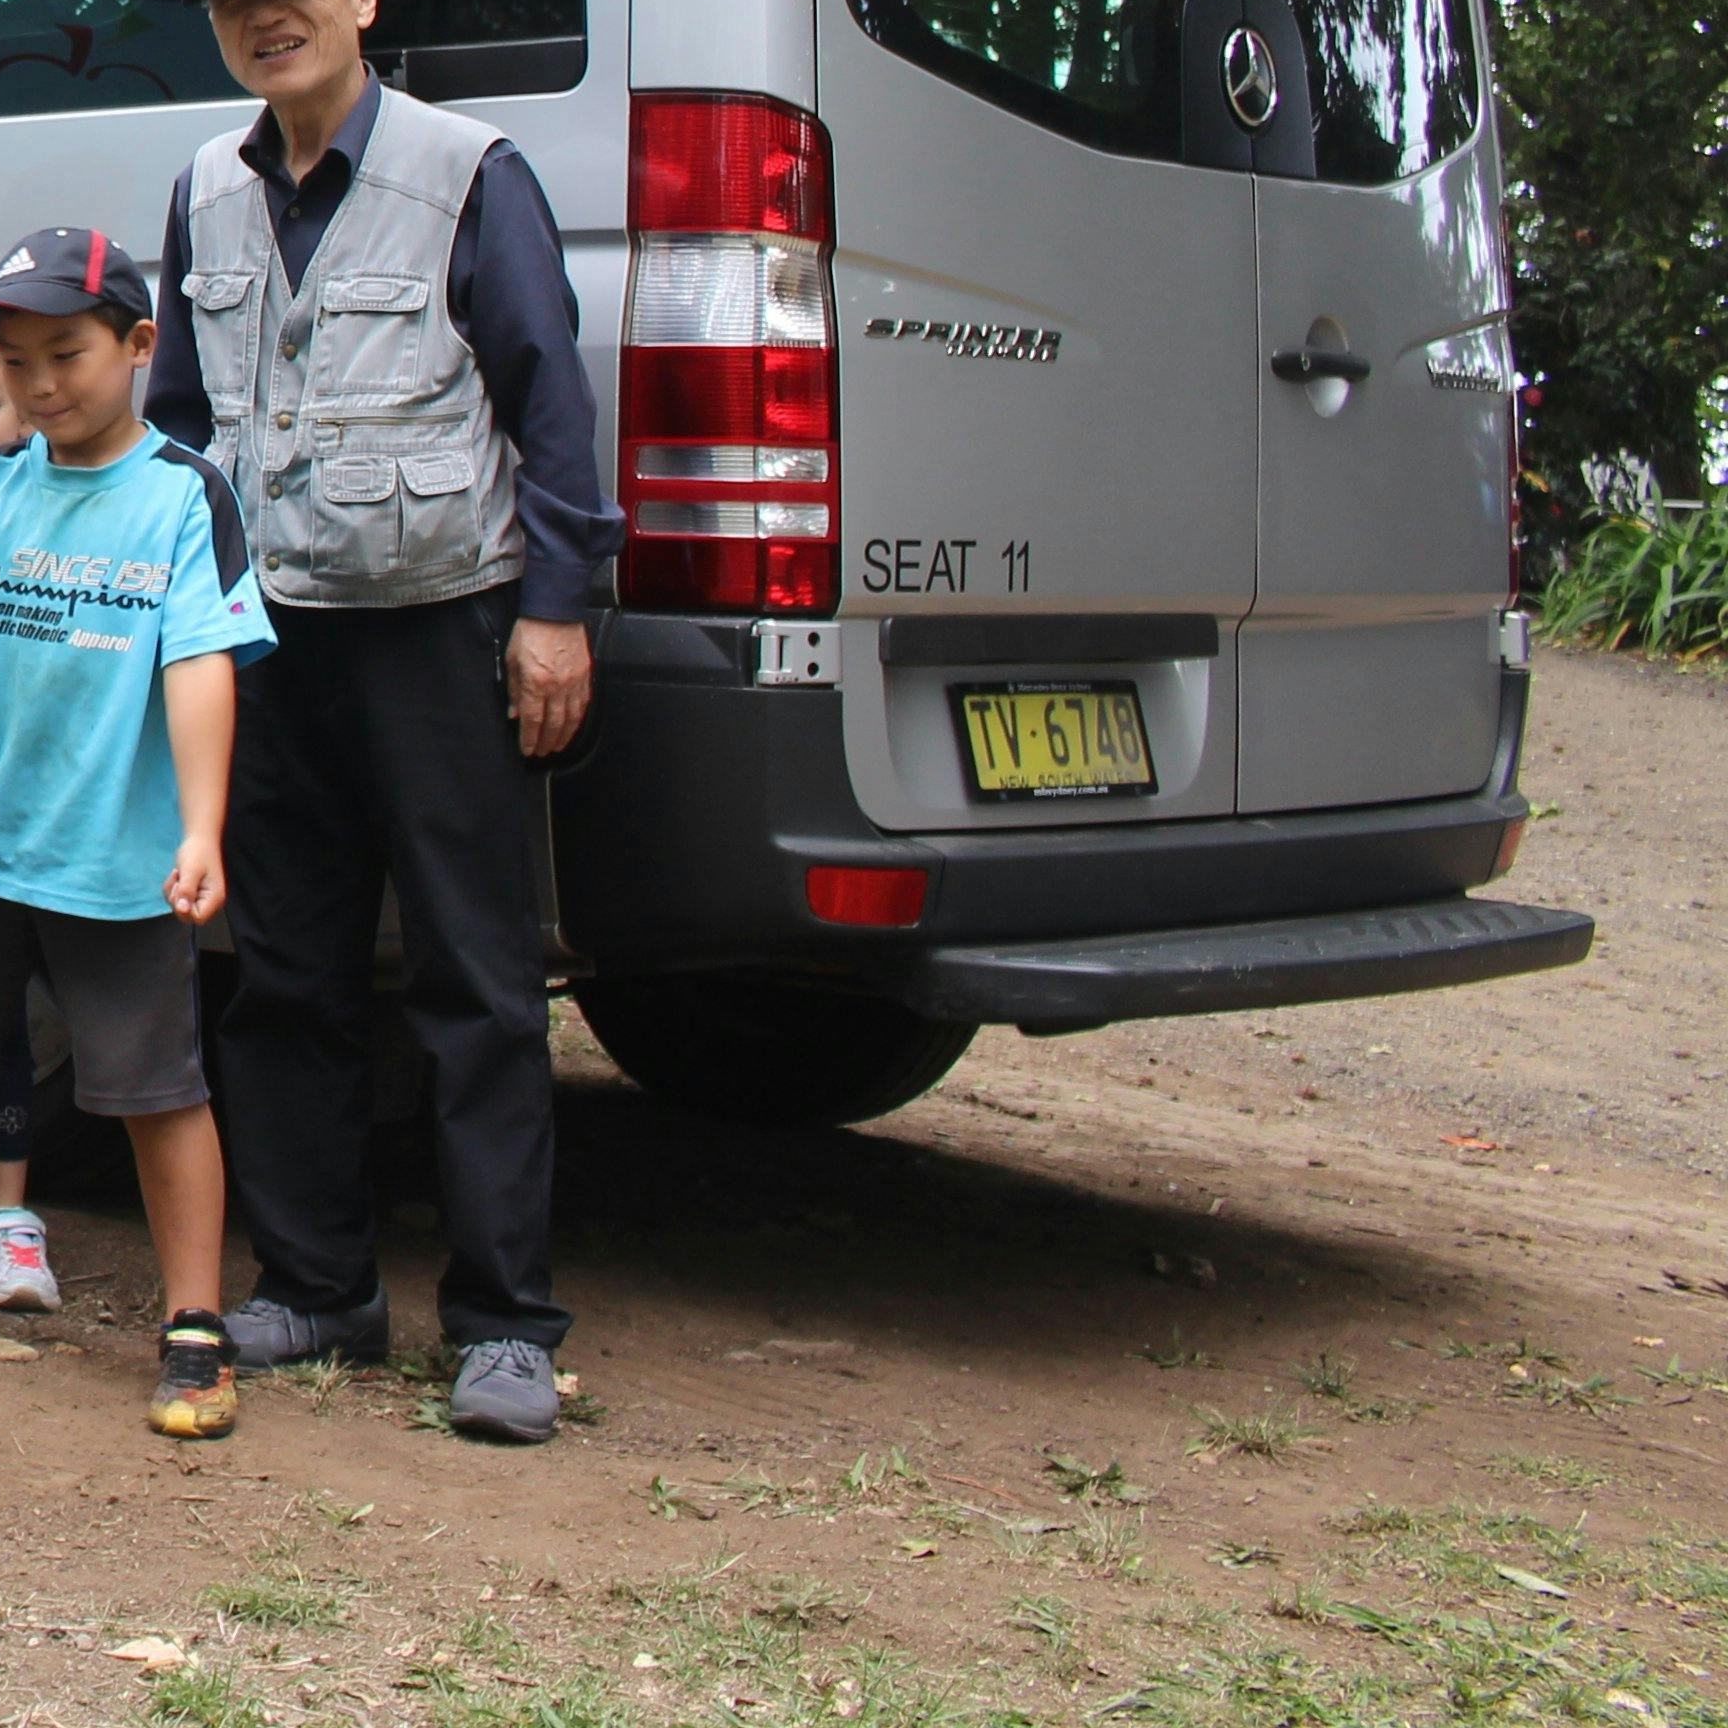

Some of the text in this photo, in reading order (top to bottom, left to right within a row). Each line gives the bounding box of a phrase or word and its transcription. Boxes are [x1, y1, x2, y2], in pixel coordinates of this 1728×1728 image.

[8, 547, 112, 587] SINCE
[863, 539, 1029, 593] SEAT 11
[68, 628, 135, 653] Apparel
